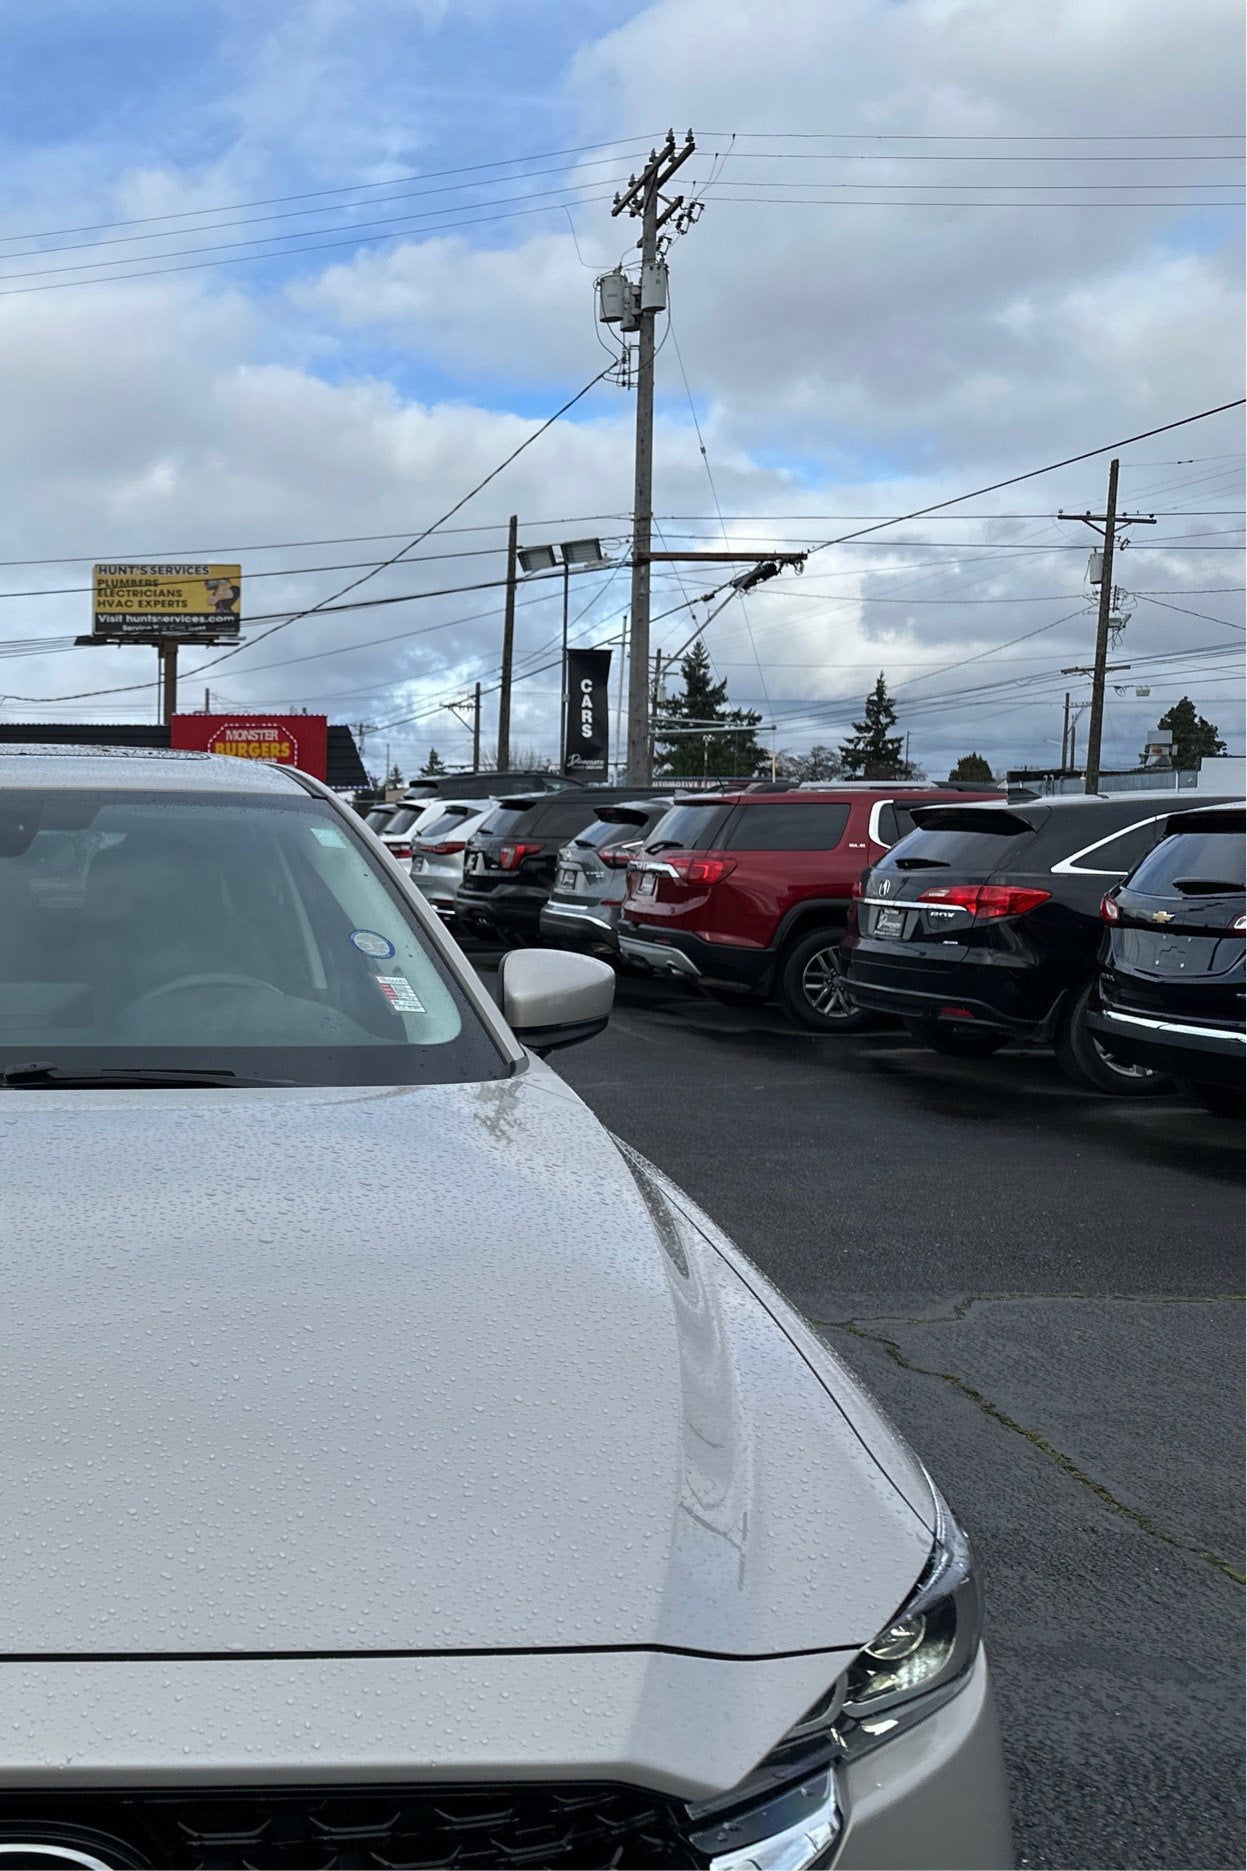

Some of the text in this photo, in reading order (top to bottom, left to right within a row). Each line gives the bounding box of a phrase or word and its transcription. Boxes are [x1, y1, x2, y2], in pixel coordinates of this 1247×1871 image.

[98, 566, 210, 575] HUNT'S SERVICES
[97, 579, 159, 588] PLUMBERS
[97, 589, 183, 598] ELECTRICIANS
[97, 600, 188, 608] HVAC EXPERTS
[98, 614, 123, 623] Visit
[580, 679, 593, 738] CARS
[225, 729, 279, 741] MONSTER
[215, 743, 290, 757] BURGERS
